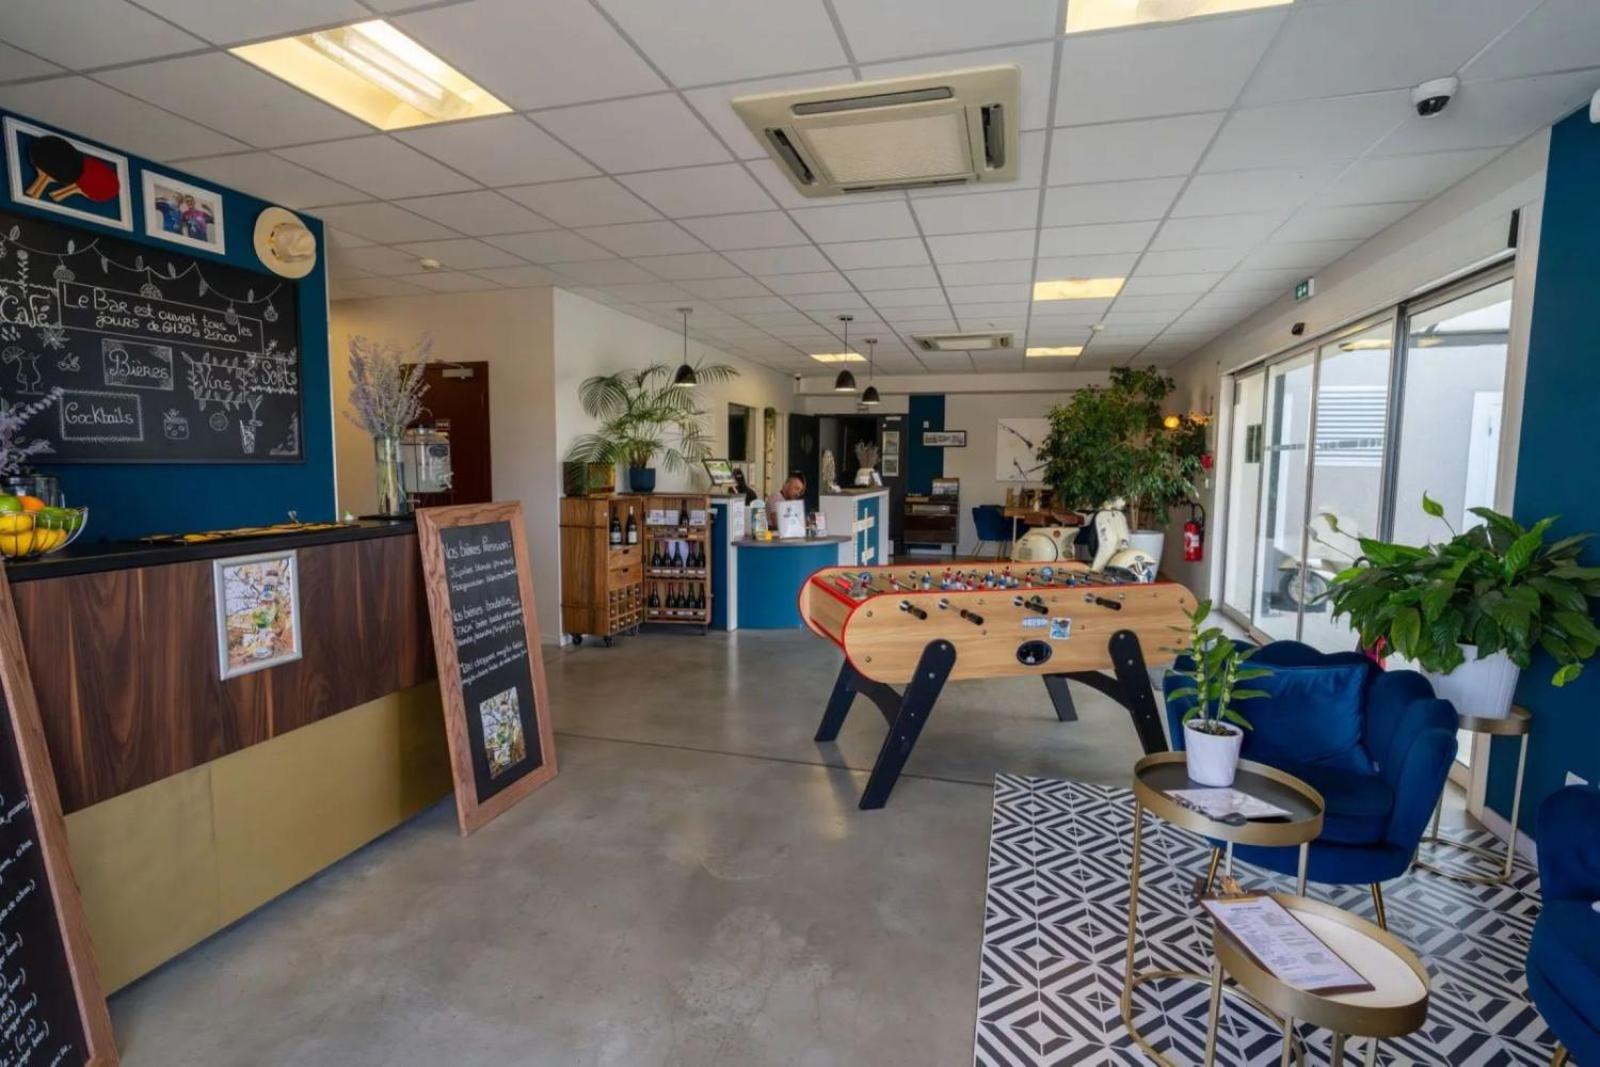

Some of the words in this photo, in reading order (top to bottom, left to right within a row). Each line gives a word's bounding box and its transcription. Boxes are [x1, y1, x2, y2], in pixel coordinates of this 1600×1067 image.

[63, 282, 89, 308] Le
[134, 304, 154, 318] est
[158, 310, 197, 326] ouvert
[202, 313, 227, 331] tous
[237, 321, 253, 337] les
[147, 322, 161, 333] de
[201, 364, 232, 391] Vins
